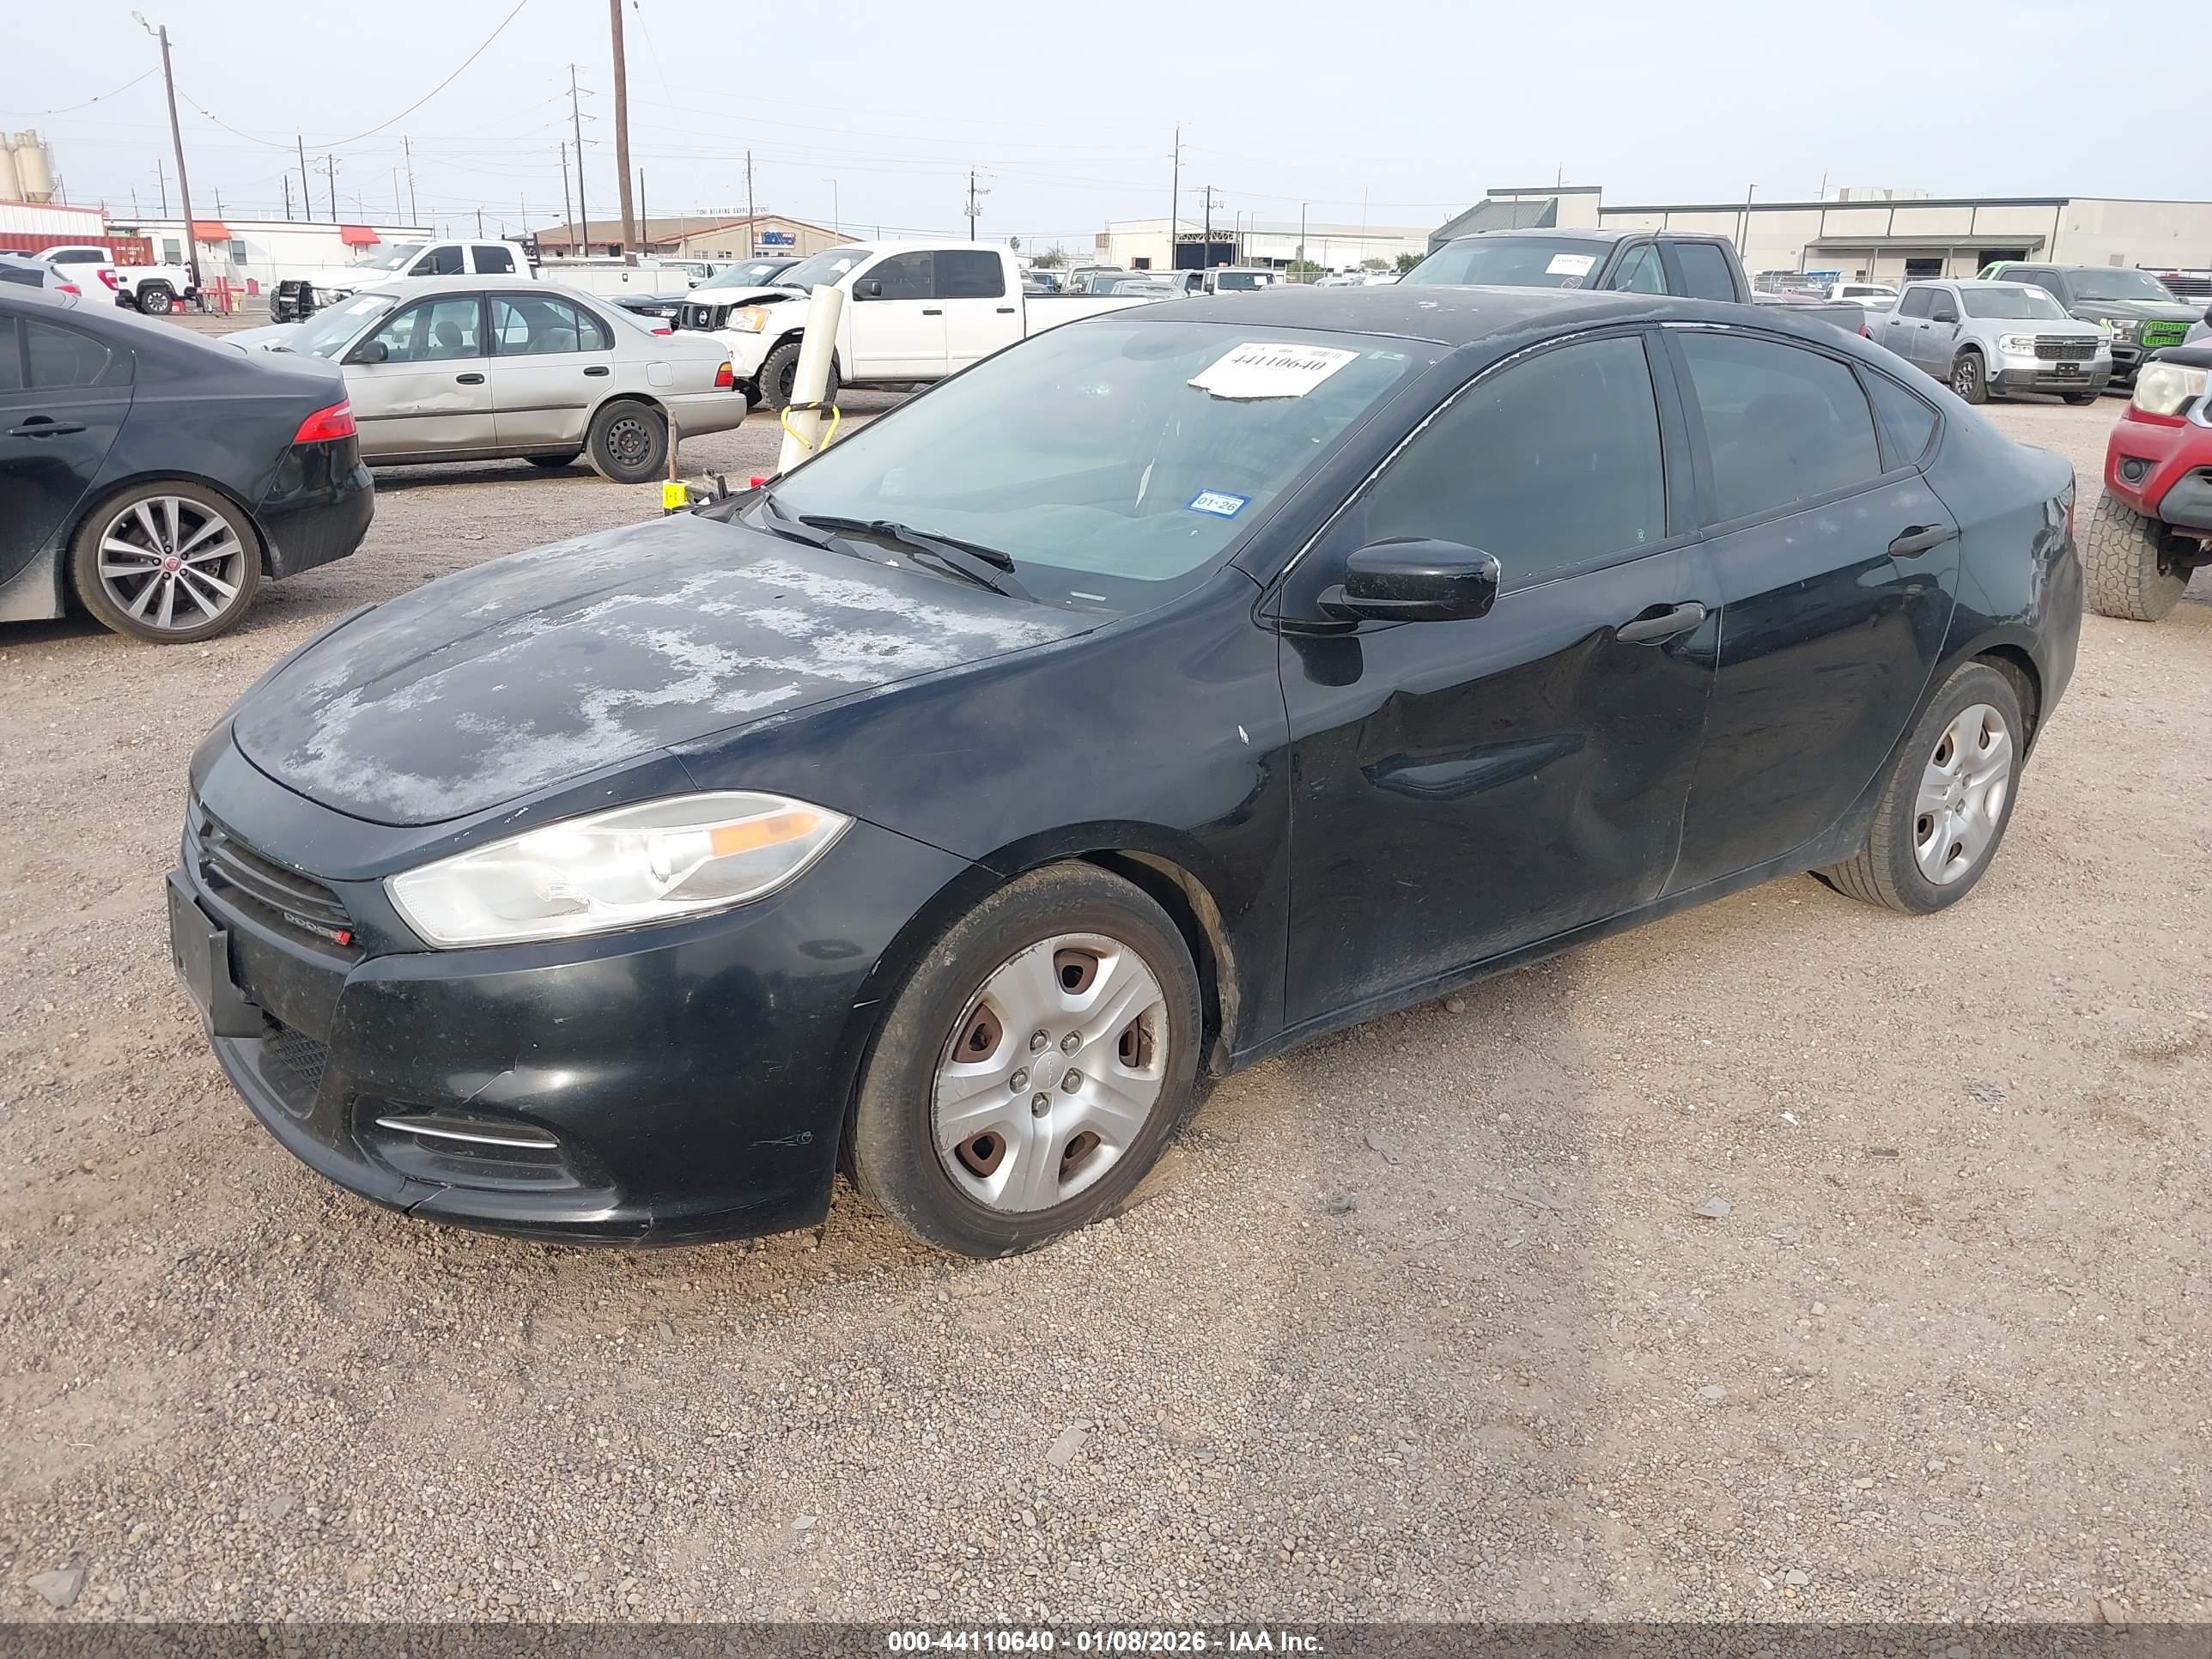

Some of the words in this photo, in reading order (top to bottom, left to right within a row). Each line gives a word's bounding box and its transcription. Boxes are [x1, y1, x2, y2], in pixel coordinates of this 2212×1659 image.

[1231, 354, 1327, 371] 44110640
[1197, 496, 1214, 507] 01
[1218, 501, 1237, 511] 26
